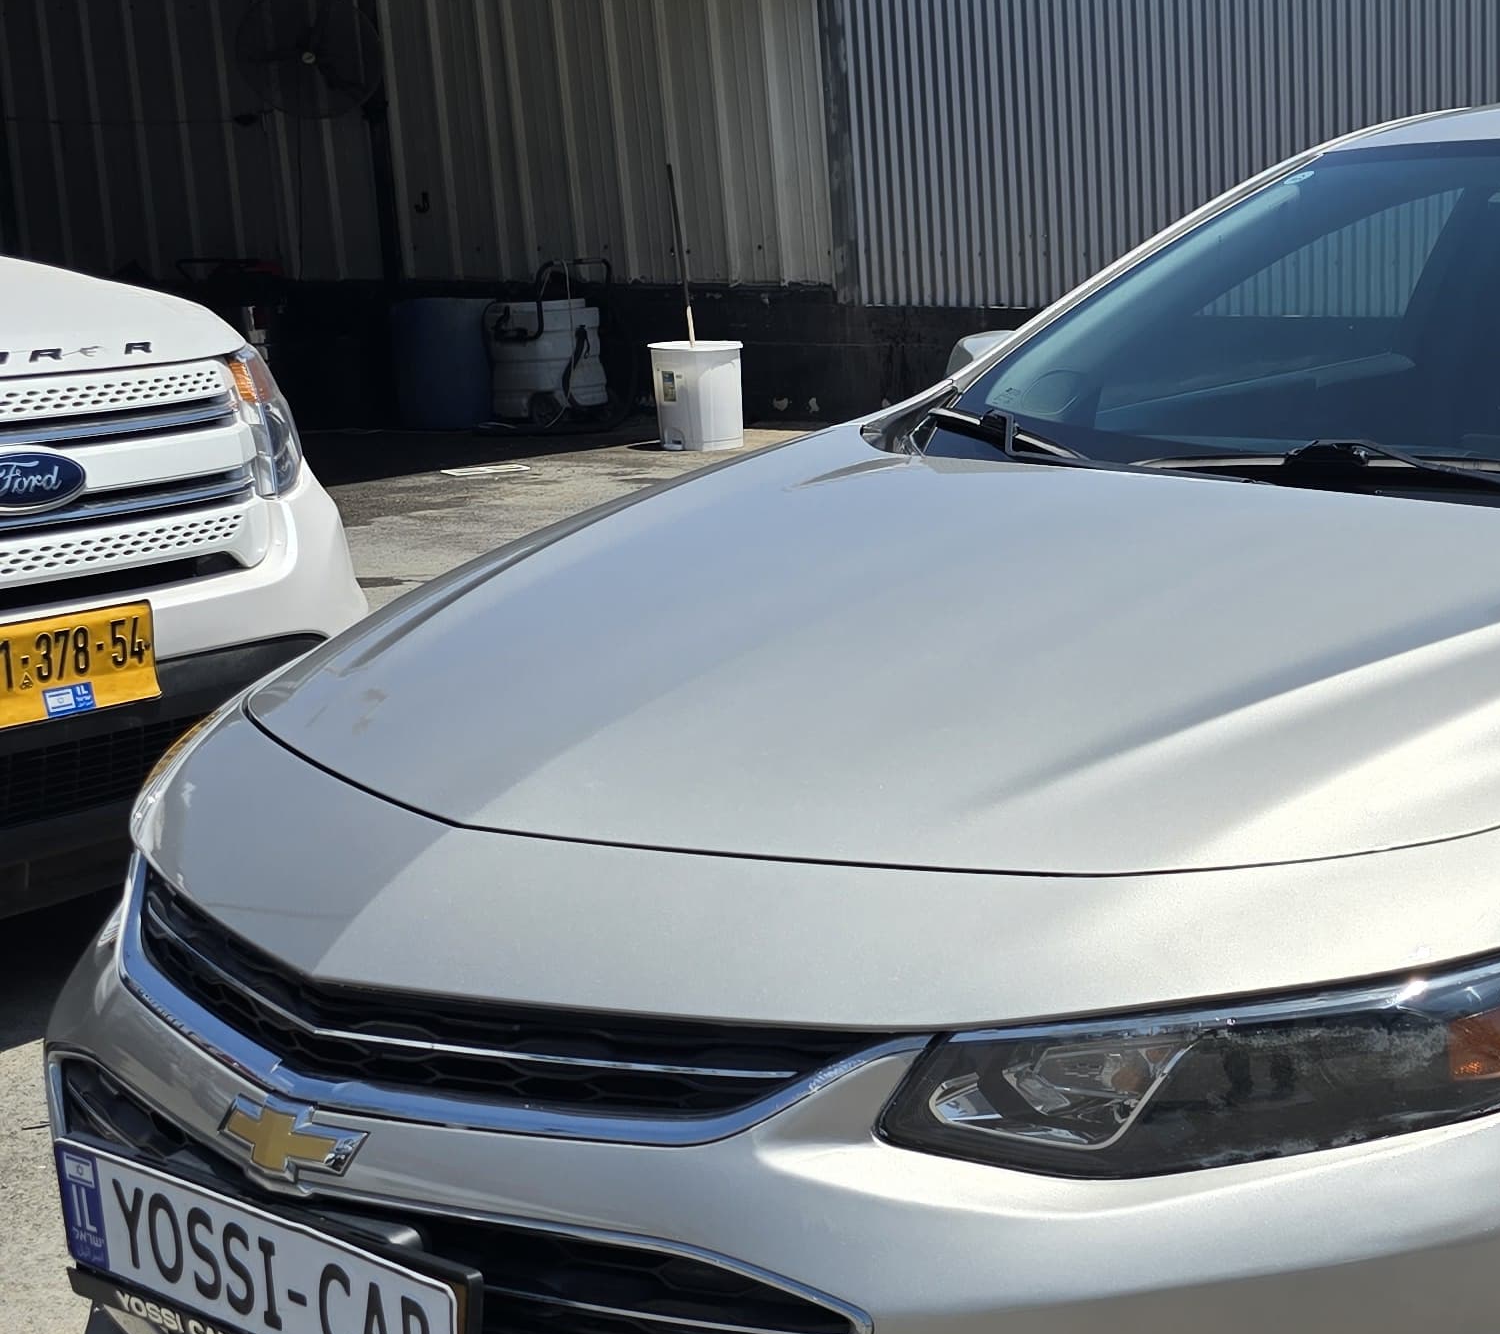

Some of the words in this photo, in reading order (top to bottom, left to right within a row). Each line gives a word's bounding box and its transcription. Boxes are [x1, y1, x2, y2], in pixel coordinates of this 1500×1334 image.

[0, 460, 62, 496] Ford
[72, 1183, 98, 1233] IL
[116, 1290, 184, 1333] YOSSI
